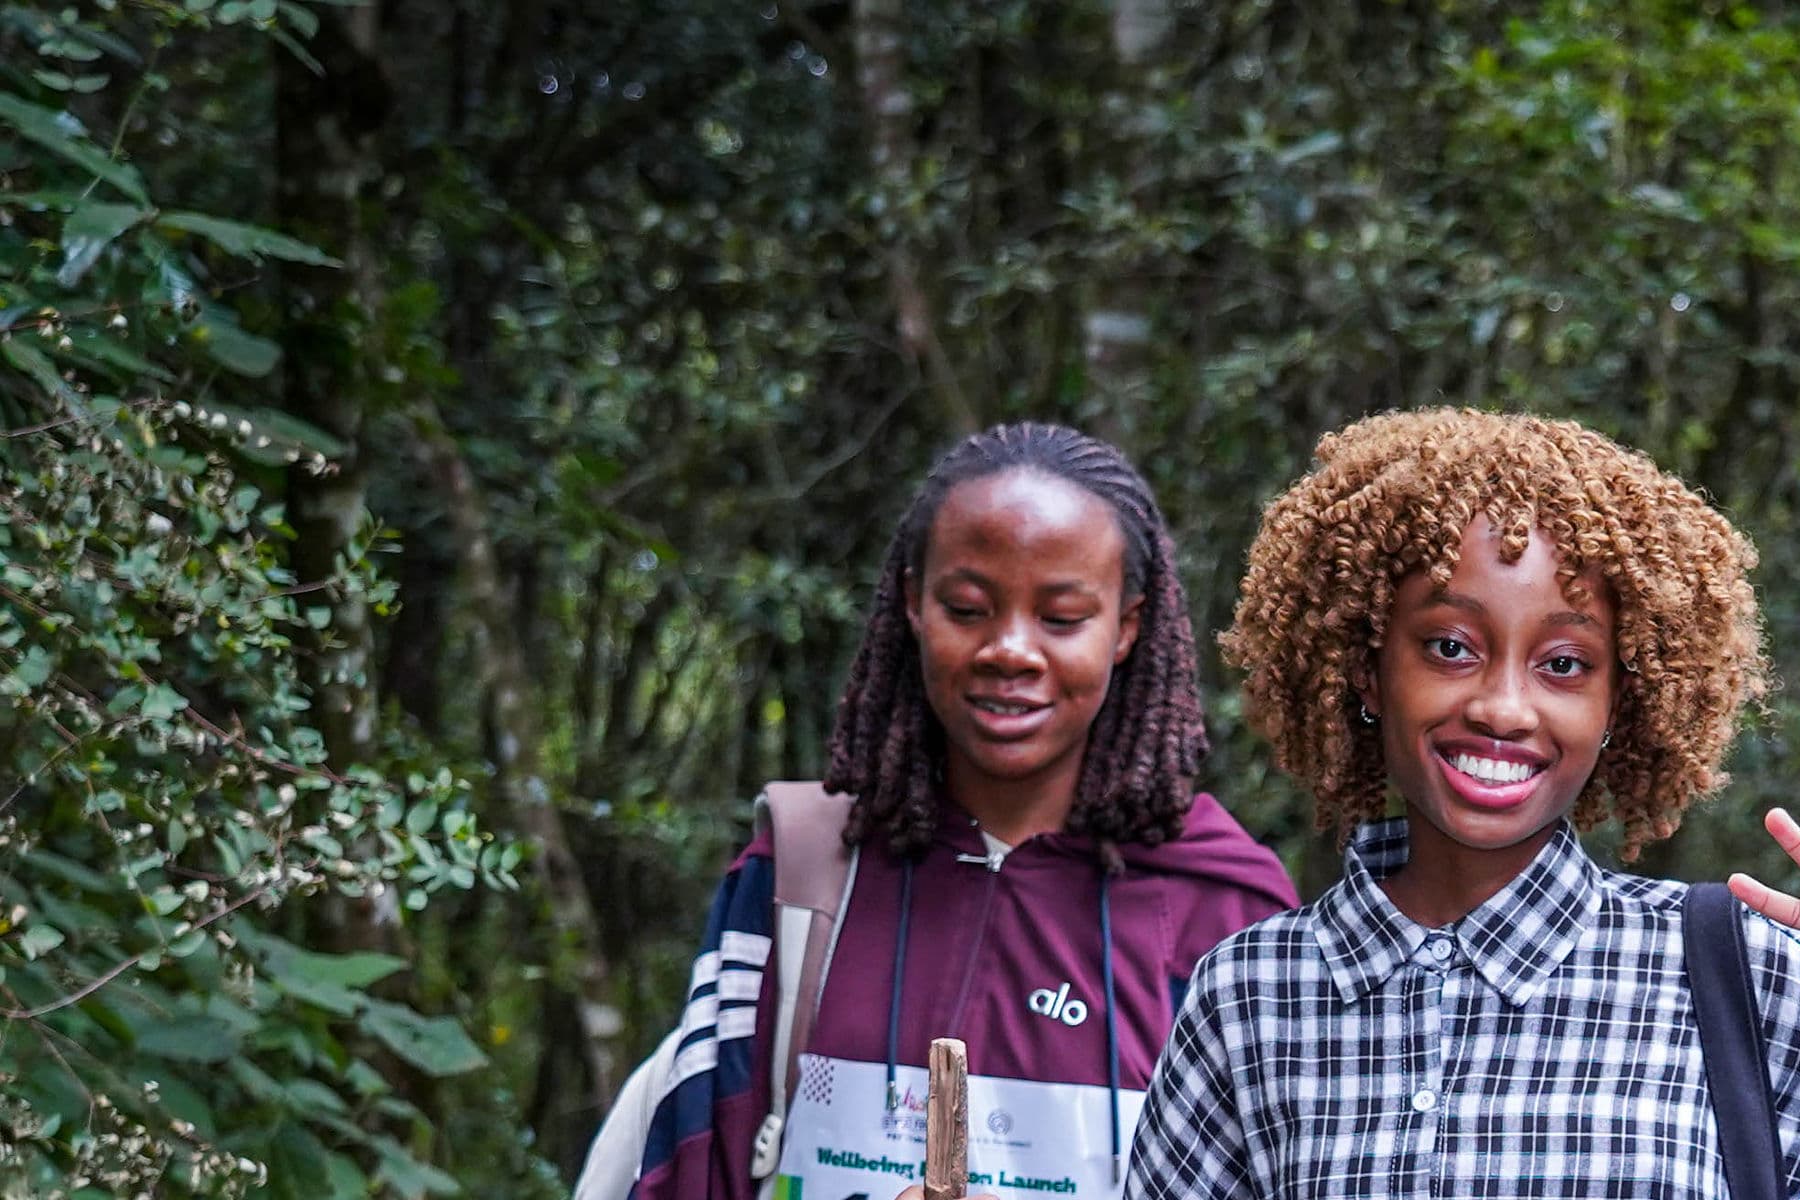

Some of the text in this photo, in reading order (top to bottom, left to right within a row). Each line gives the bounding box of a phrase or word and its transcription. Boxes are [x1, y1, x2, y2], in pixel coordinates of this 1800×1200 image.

[1029, 982, 1088, 1026] alo
[817, 1148, 915, 1180] Wellbeing
[999, 1170, 1077, 1194] Launch
